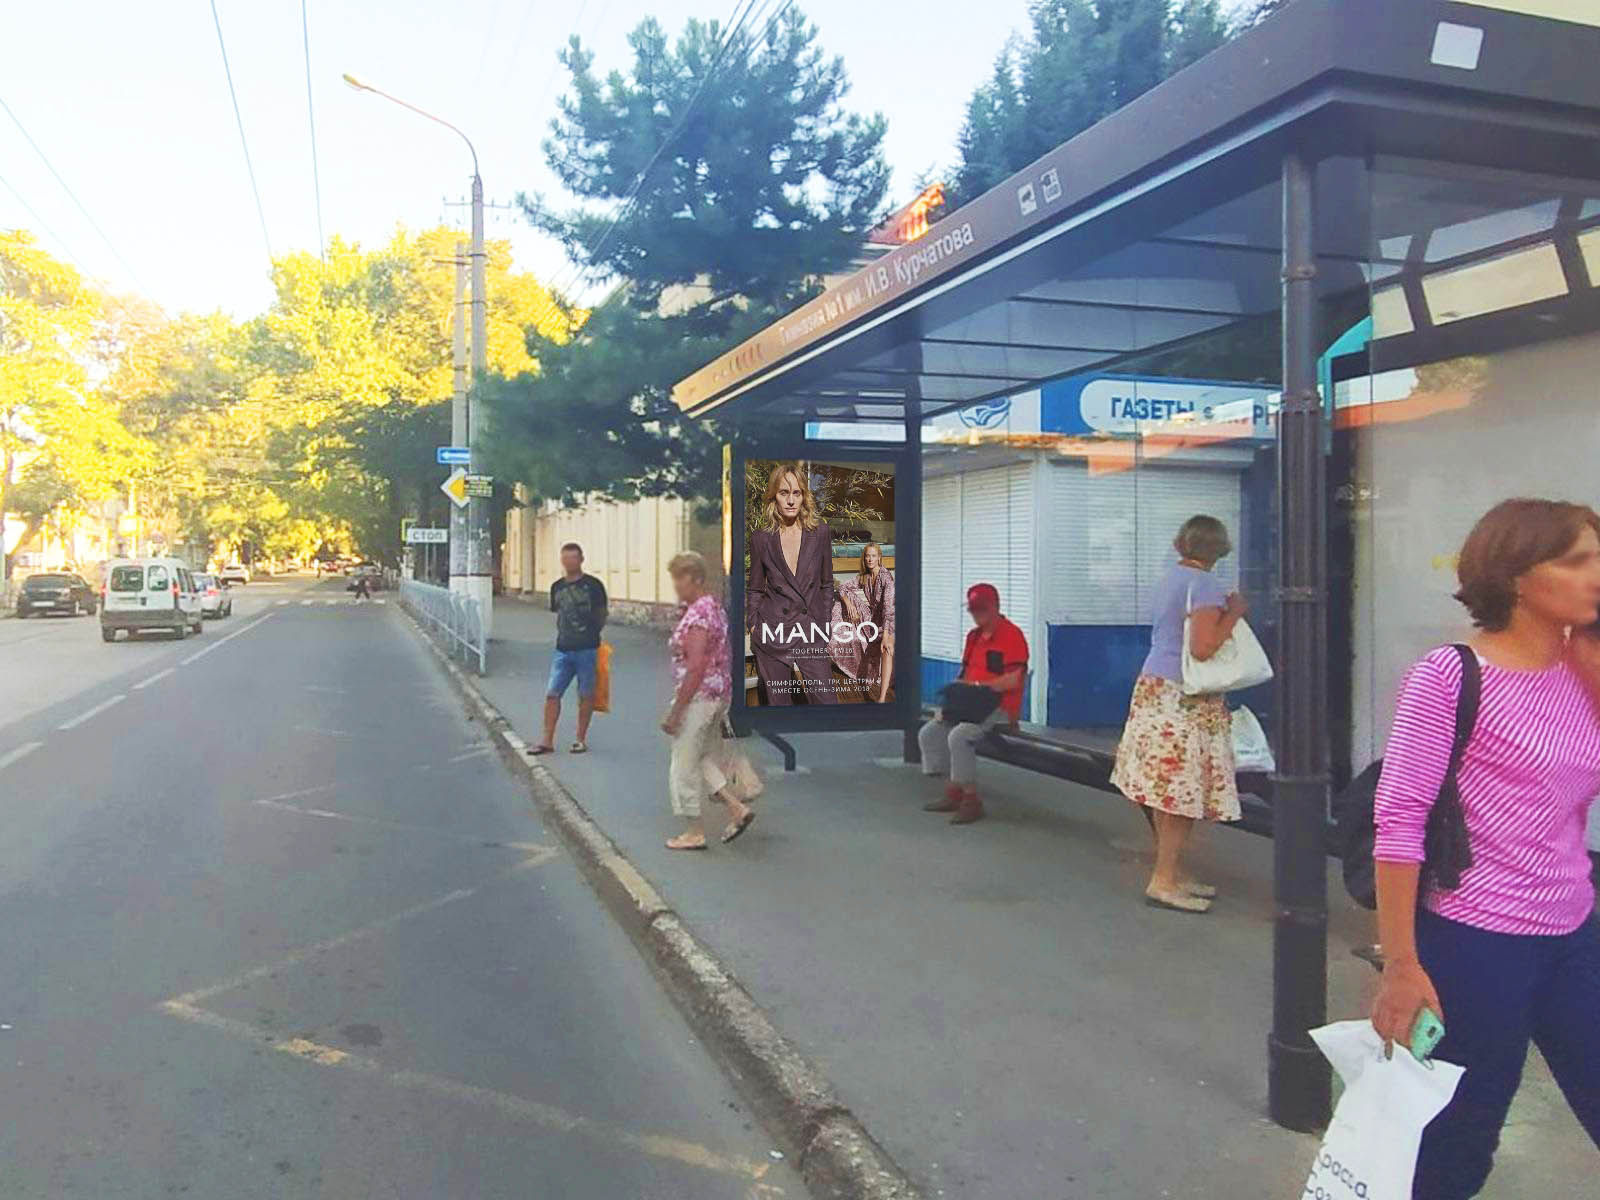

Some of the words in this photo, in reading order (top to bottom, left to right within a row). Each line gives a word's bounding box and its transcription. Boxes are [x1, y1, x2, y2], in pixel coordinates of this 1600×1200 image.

[865, 266, 894, 299] И.В.
[894, 222, 975, 285] Курчатова
[1111, 397, 1195, 420] ГАЗЕТЫ
[761, 621, 879, 644] MANGO
